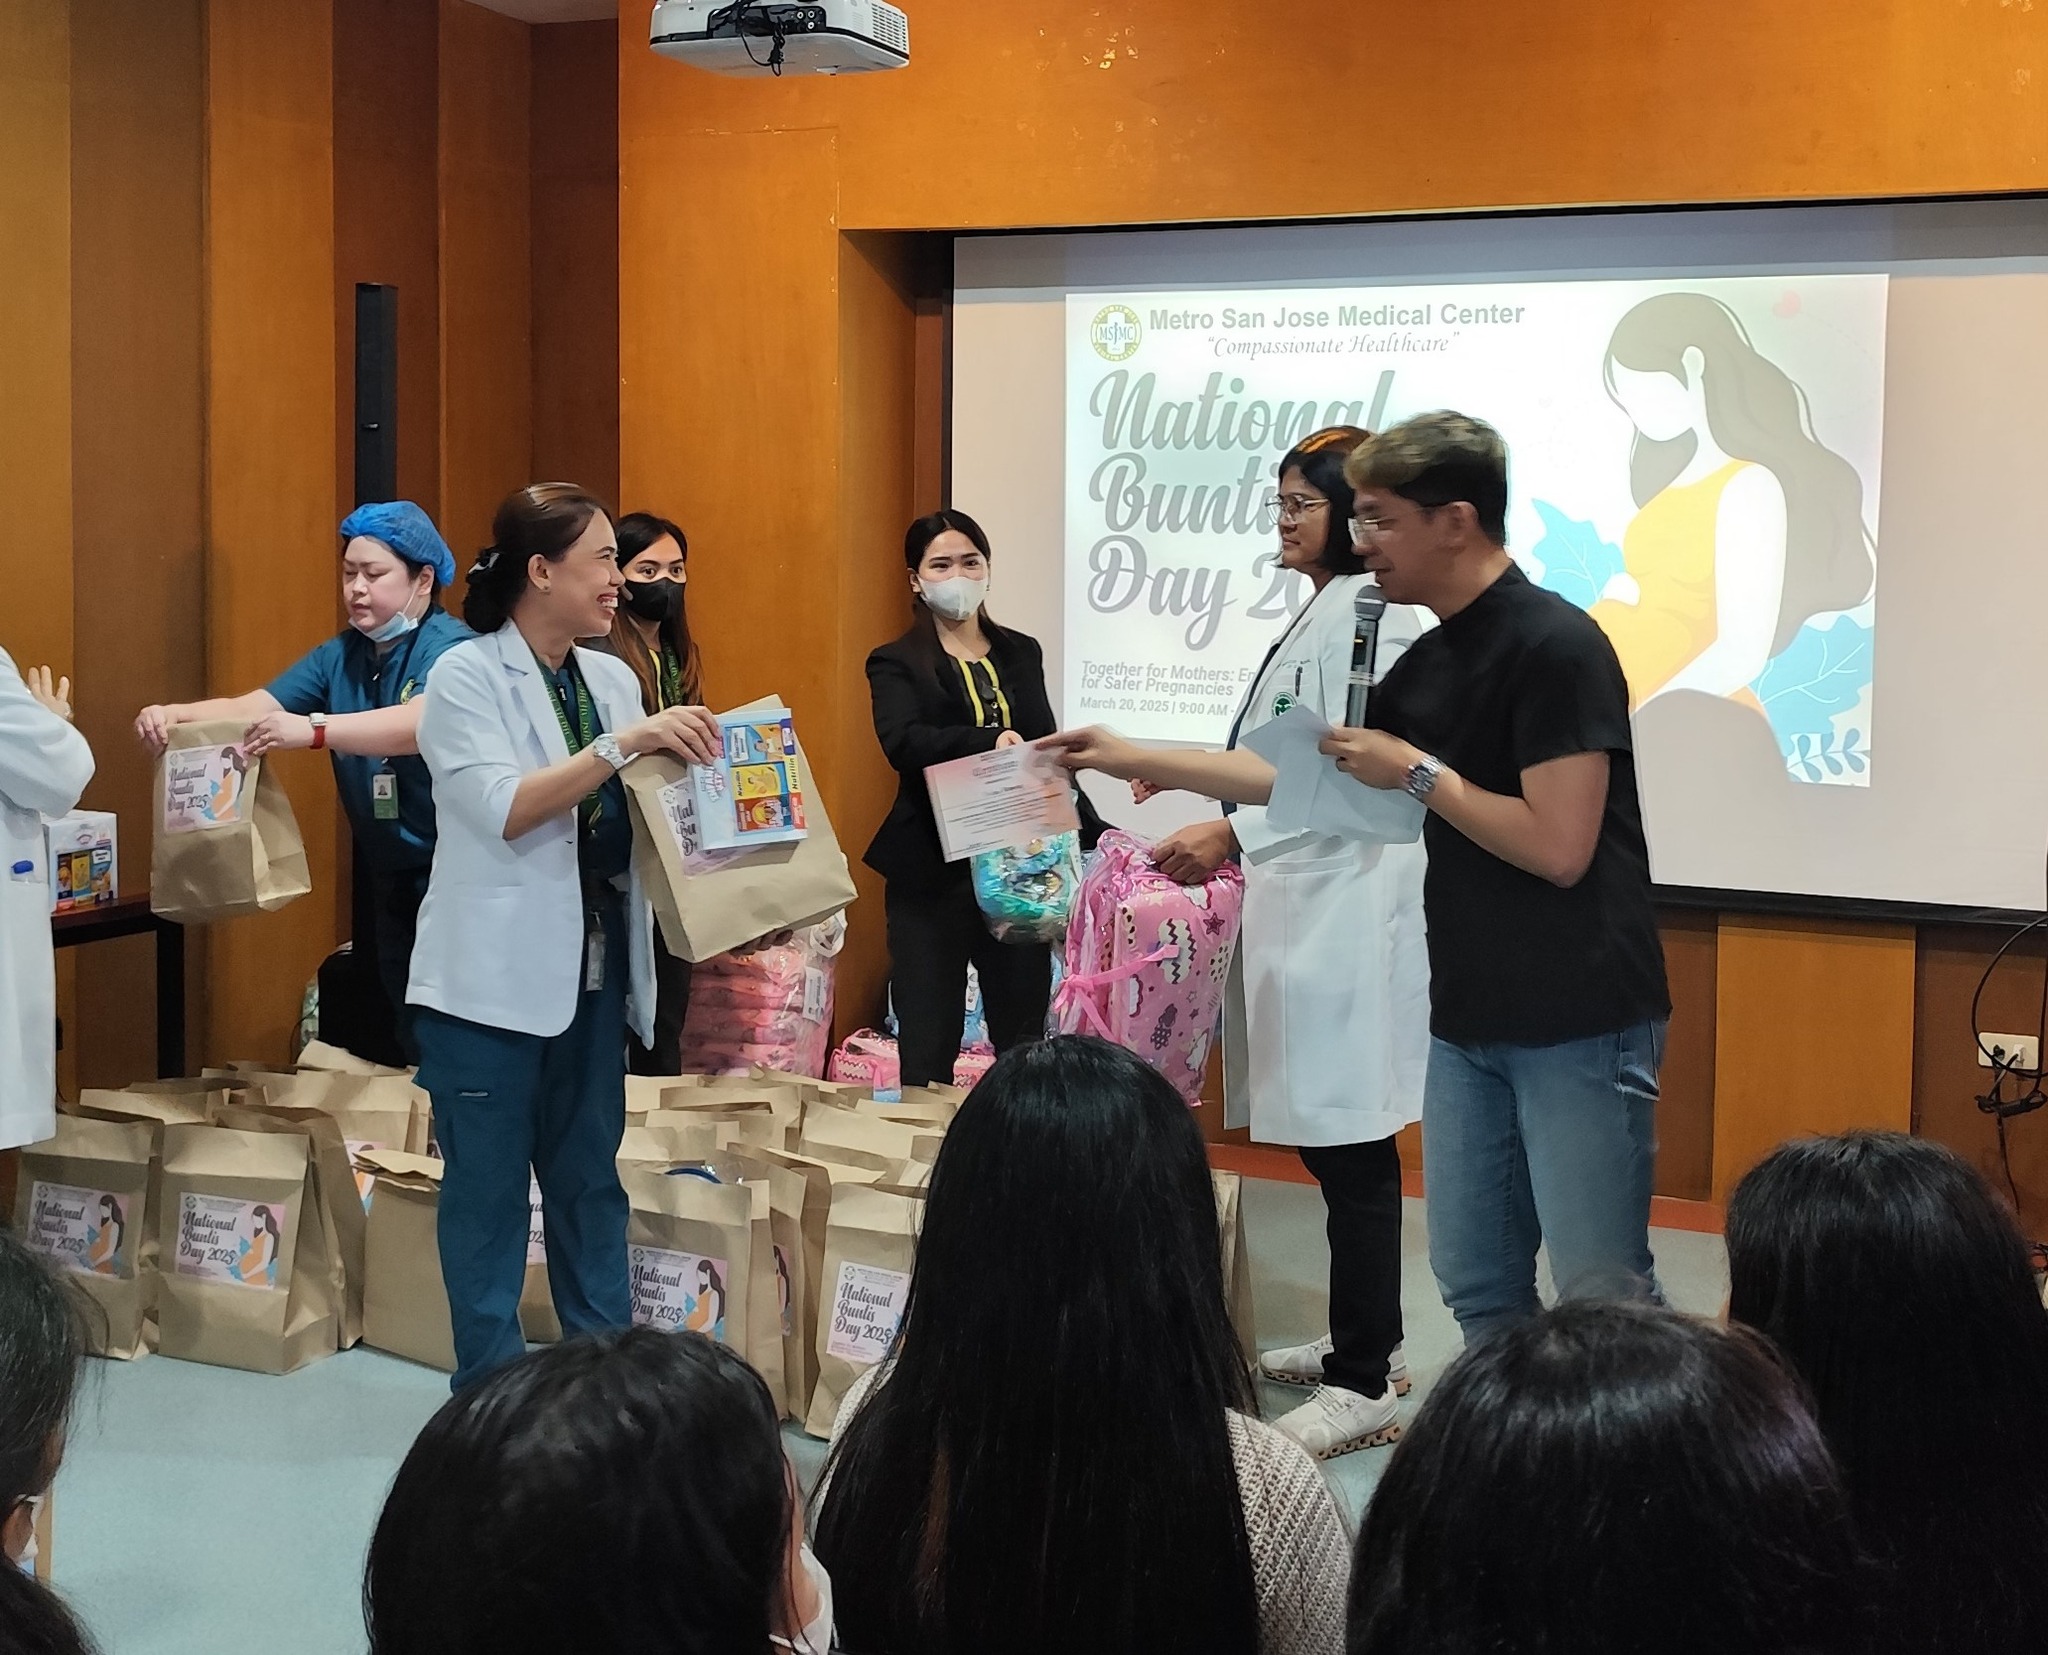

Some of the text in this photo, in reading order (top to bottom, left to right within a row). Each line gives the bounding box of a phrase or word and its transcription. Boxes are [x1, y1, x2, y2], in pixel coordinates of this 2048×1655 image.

[1149, 309, 1214, 330] Metro
[1221, 307, 1265, 329] San
[1273, 306, 1329, 328] Jose
[1338, 304, 1431, 326] Medical
[1440, 303, 1526, 324] Center
[1089, 452, 1281, 535] Bunti
[1087, 535, 1238, 651] Day
[1082, 660, 1144, 678] Together
[1146, 662, 1168, 679] for
[1170, 665, 1235, 682] Mothers:
[1081, 674, 1234, 696] for Safer Pregnancies
[1080, 697, 1116, 710] March
[1119, 698, 1136, 712] 20,
[1139, 699, 1169, 713] 2025
[1179, 701, 1205, 715] 9:00
[1207, 703, 1228, 716] AM
[183, 1211, 237, 1231] National
[180, 1240, 205, 1265] Day
[631, 1264, 682, 1287] National
[631, 1281, 666, 1303] Buntis
[840, 1282, 893, 1307] National
[631, 1296, 654, 1322] Day
[838, 1299, 875, 1322] Buntis
[834, 1315, 861, 1342] Day
